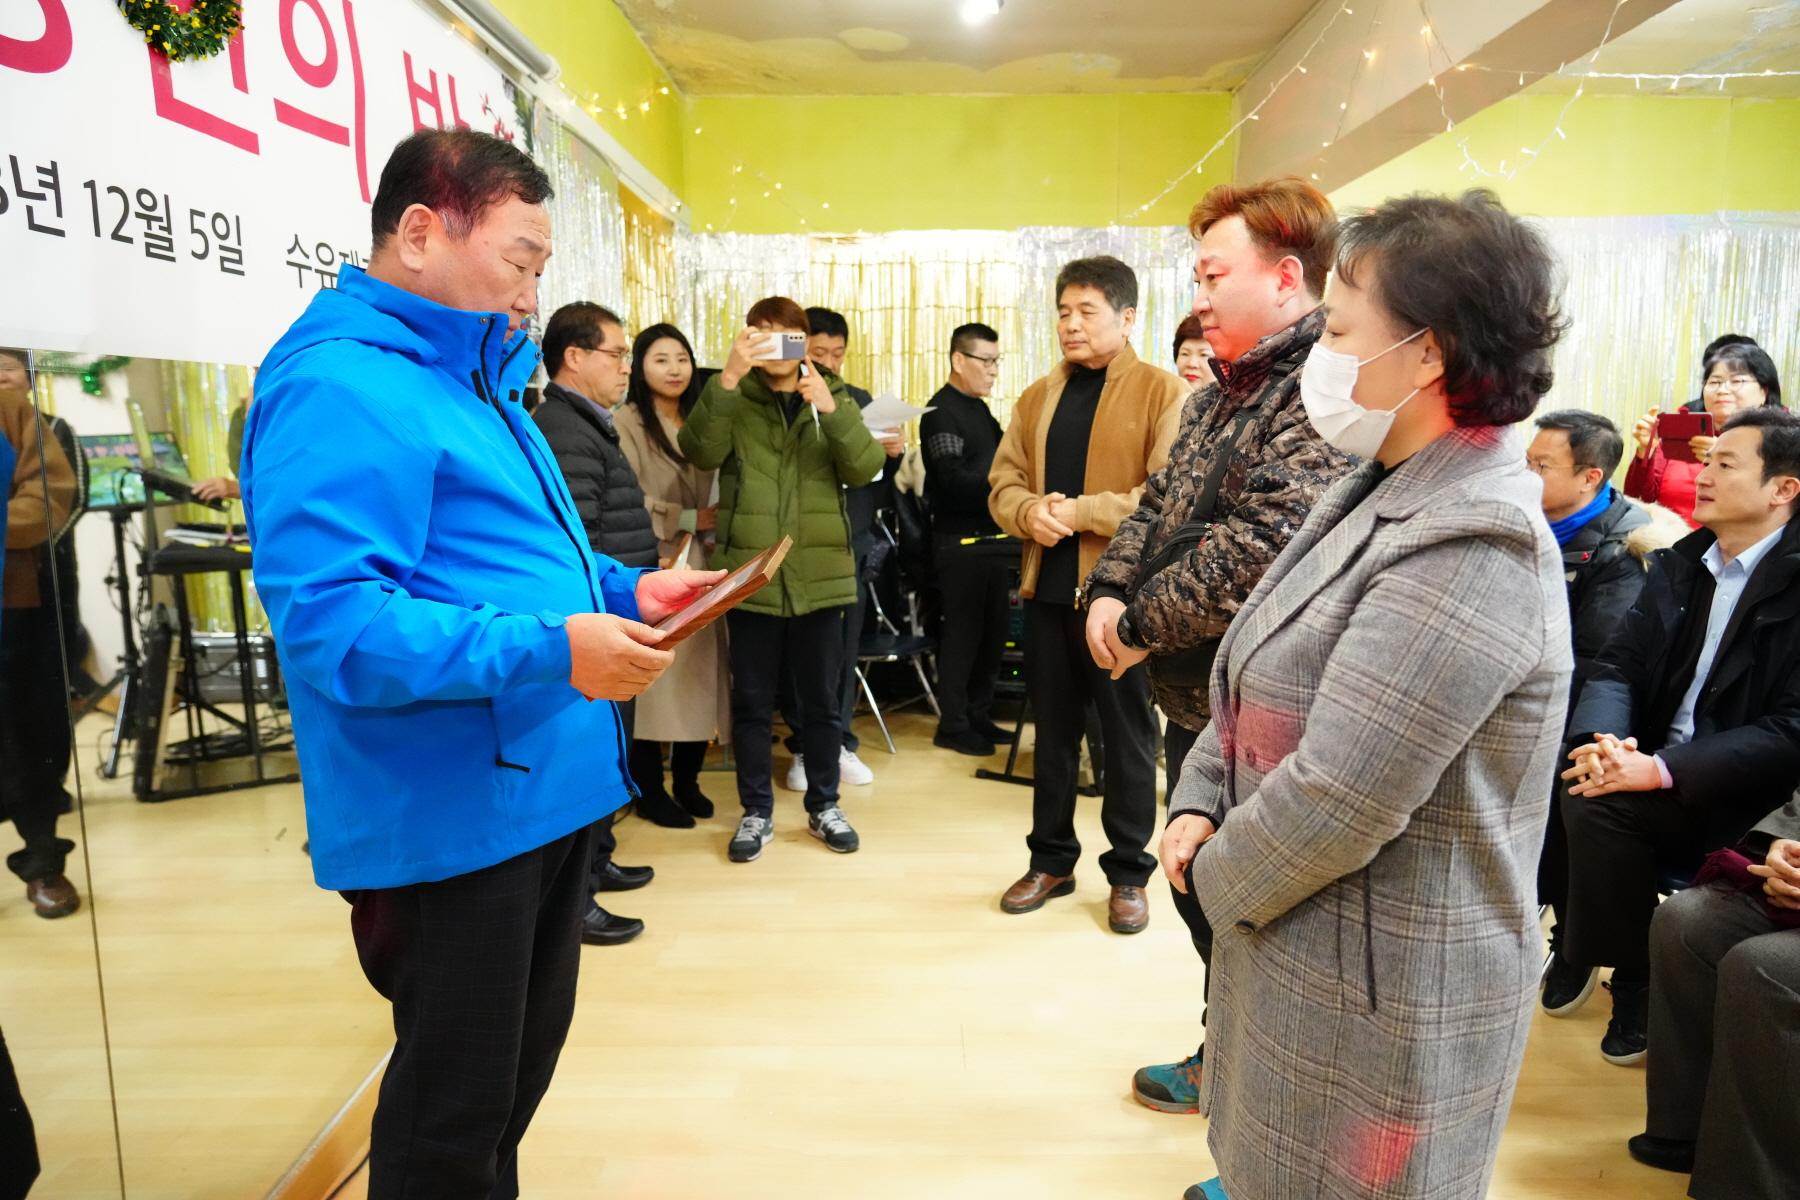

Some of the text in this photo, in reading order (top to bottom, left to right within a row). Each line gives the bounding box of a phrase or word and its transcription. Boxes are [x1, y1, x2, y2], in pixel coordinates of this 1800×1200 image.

[0, 154, 66, 238] 년
[83, 179, 176, 263] 12월
[189, 208, 245, 276] 5일
